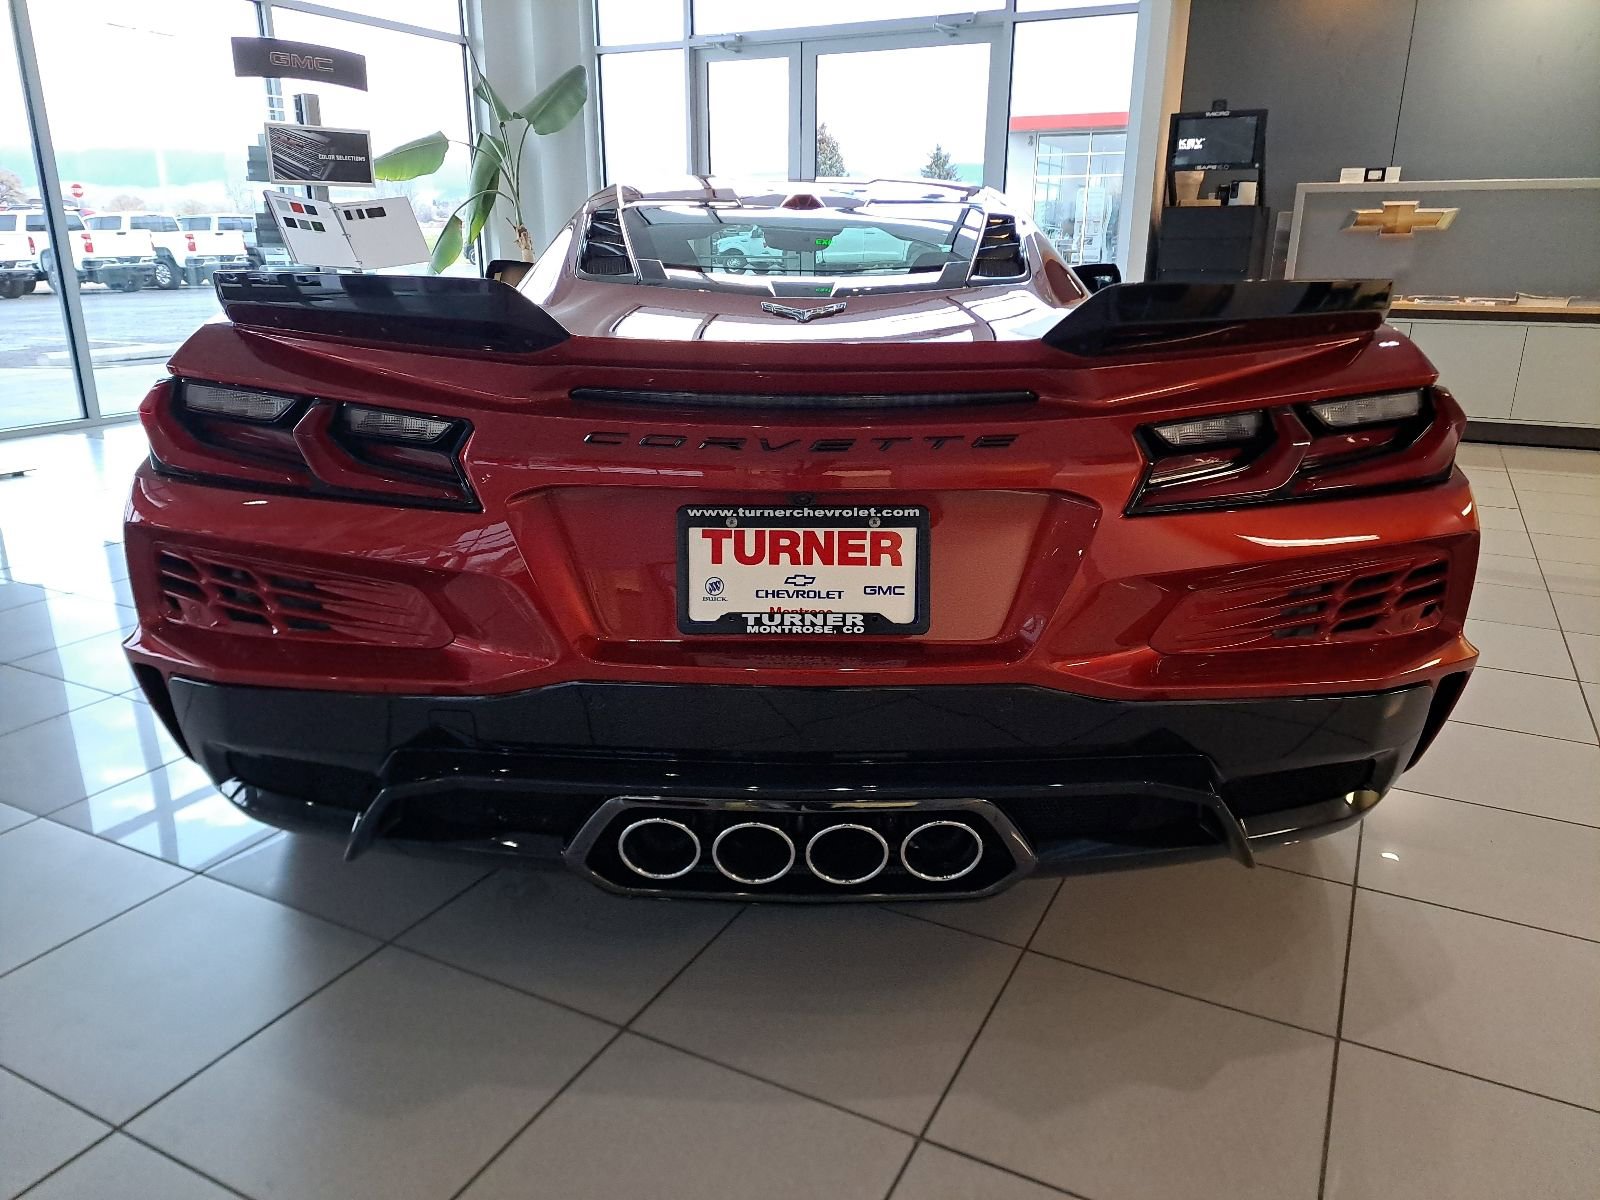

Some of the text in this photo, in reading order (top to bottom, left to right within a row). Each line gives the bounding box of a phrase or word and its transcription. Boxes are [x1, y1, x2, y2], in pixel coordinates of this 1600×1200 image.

[269, 51, 334, 73] GMC
[318, 153, 366, 162] COLOR SELECTIONS
[583, 431, 1020, 452] CORVETTE
[686, 507, 920, 518] www.turnerchevrolet.com
[701, 528, 903, 567] TURNER
[755, 589, 845, 600] CHEVROLET
[863, 585, 906, 596] GMC
[741, 613, 865, 626] TURNER
[746, 625, 865, 635] MONTROSE, CO
